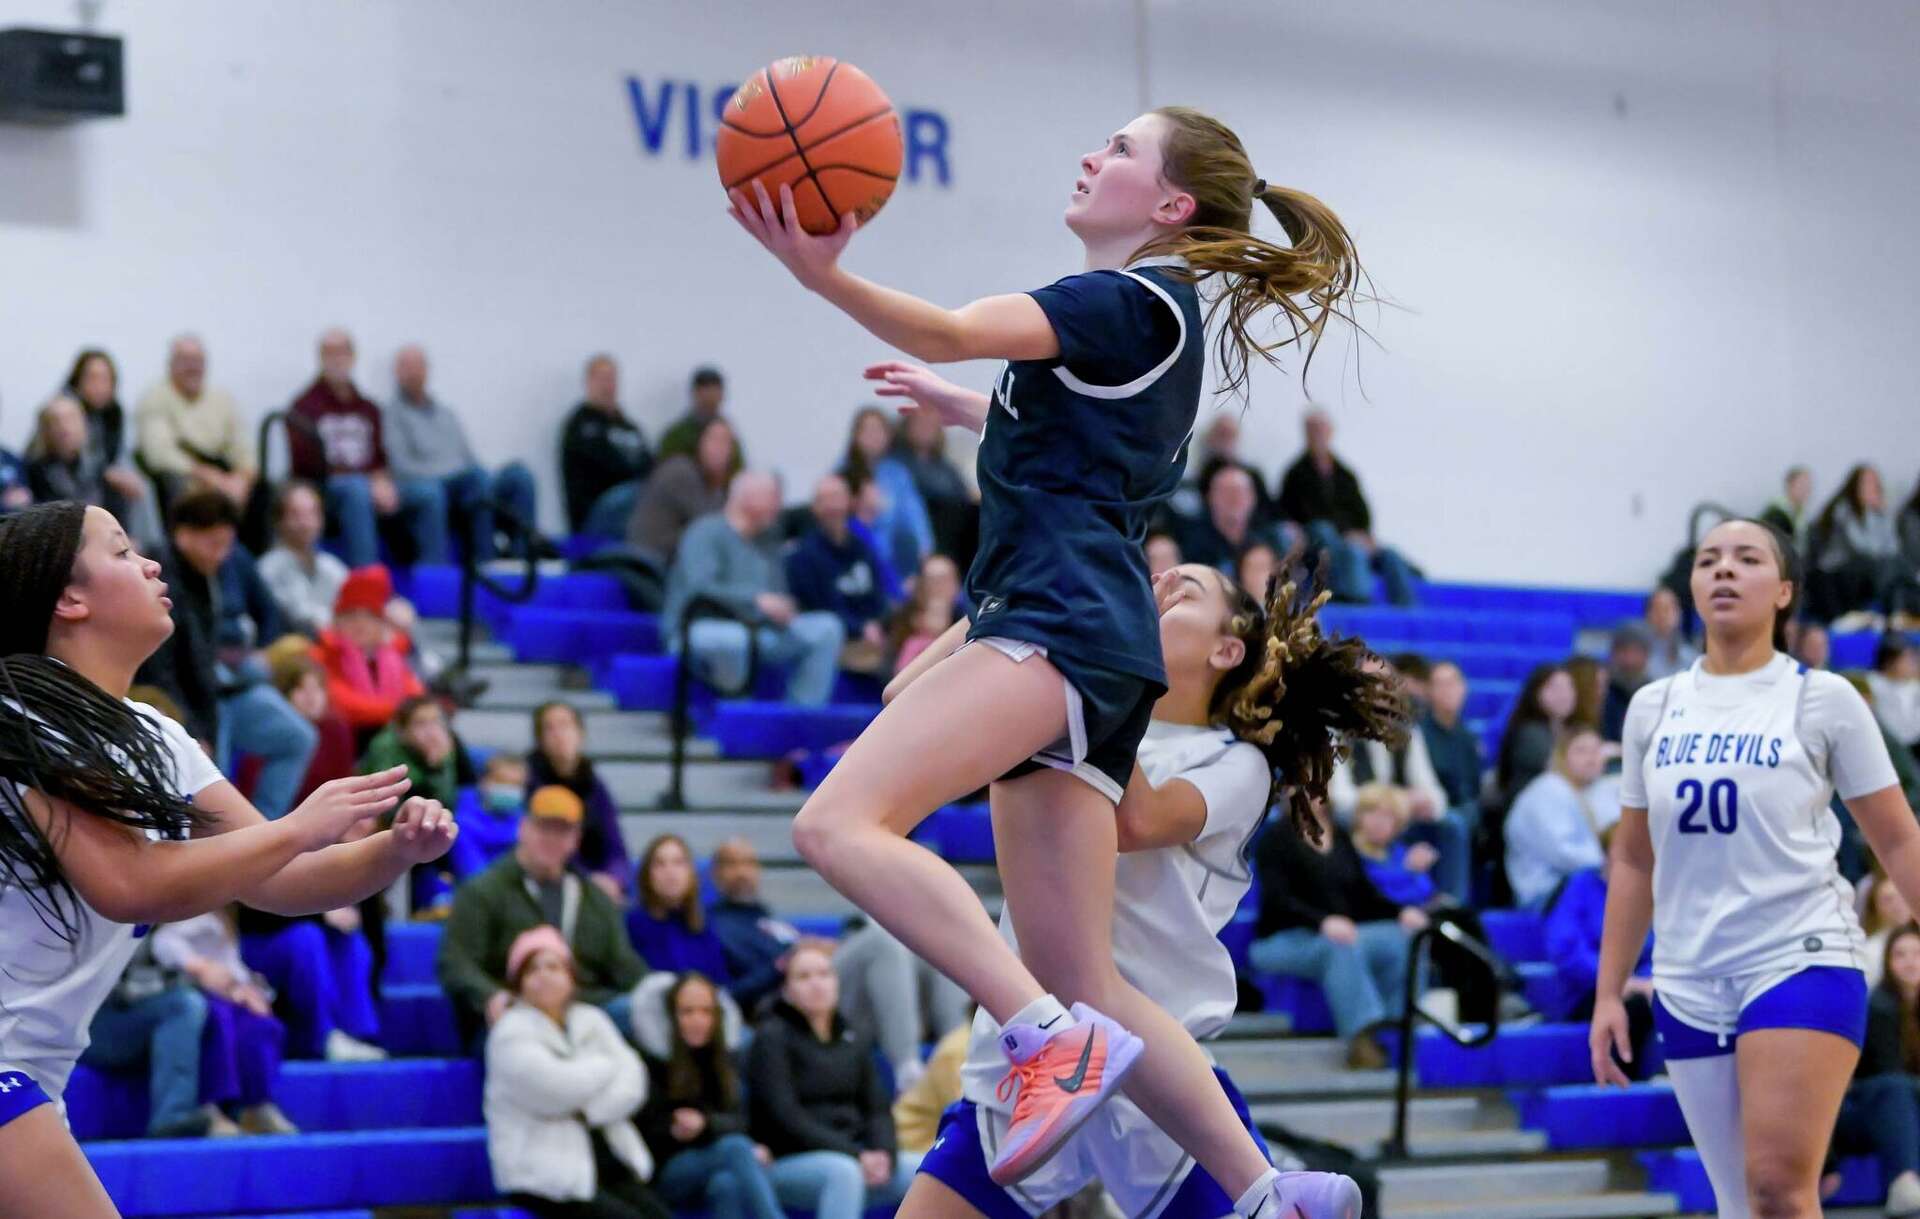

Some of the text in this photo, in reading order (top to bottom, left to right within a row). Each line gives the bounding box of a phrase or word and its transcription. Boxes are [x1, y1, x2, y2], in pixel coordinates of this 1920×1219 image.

[1655, 733, 1783, 769] BLUE DEVILS
[1676, 777, 1738, 834] 20
